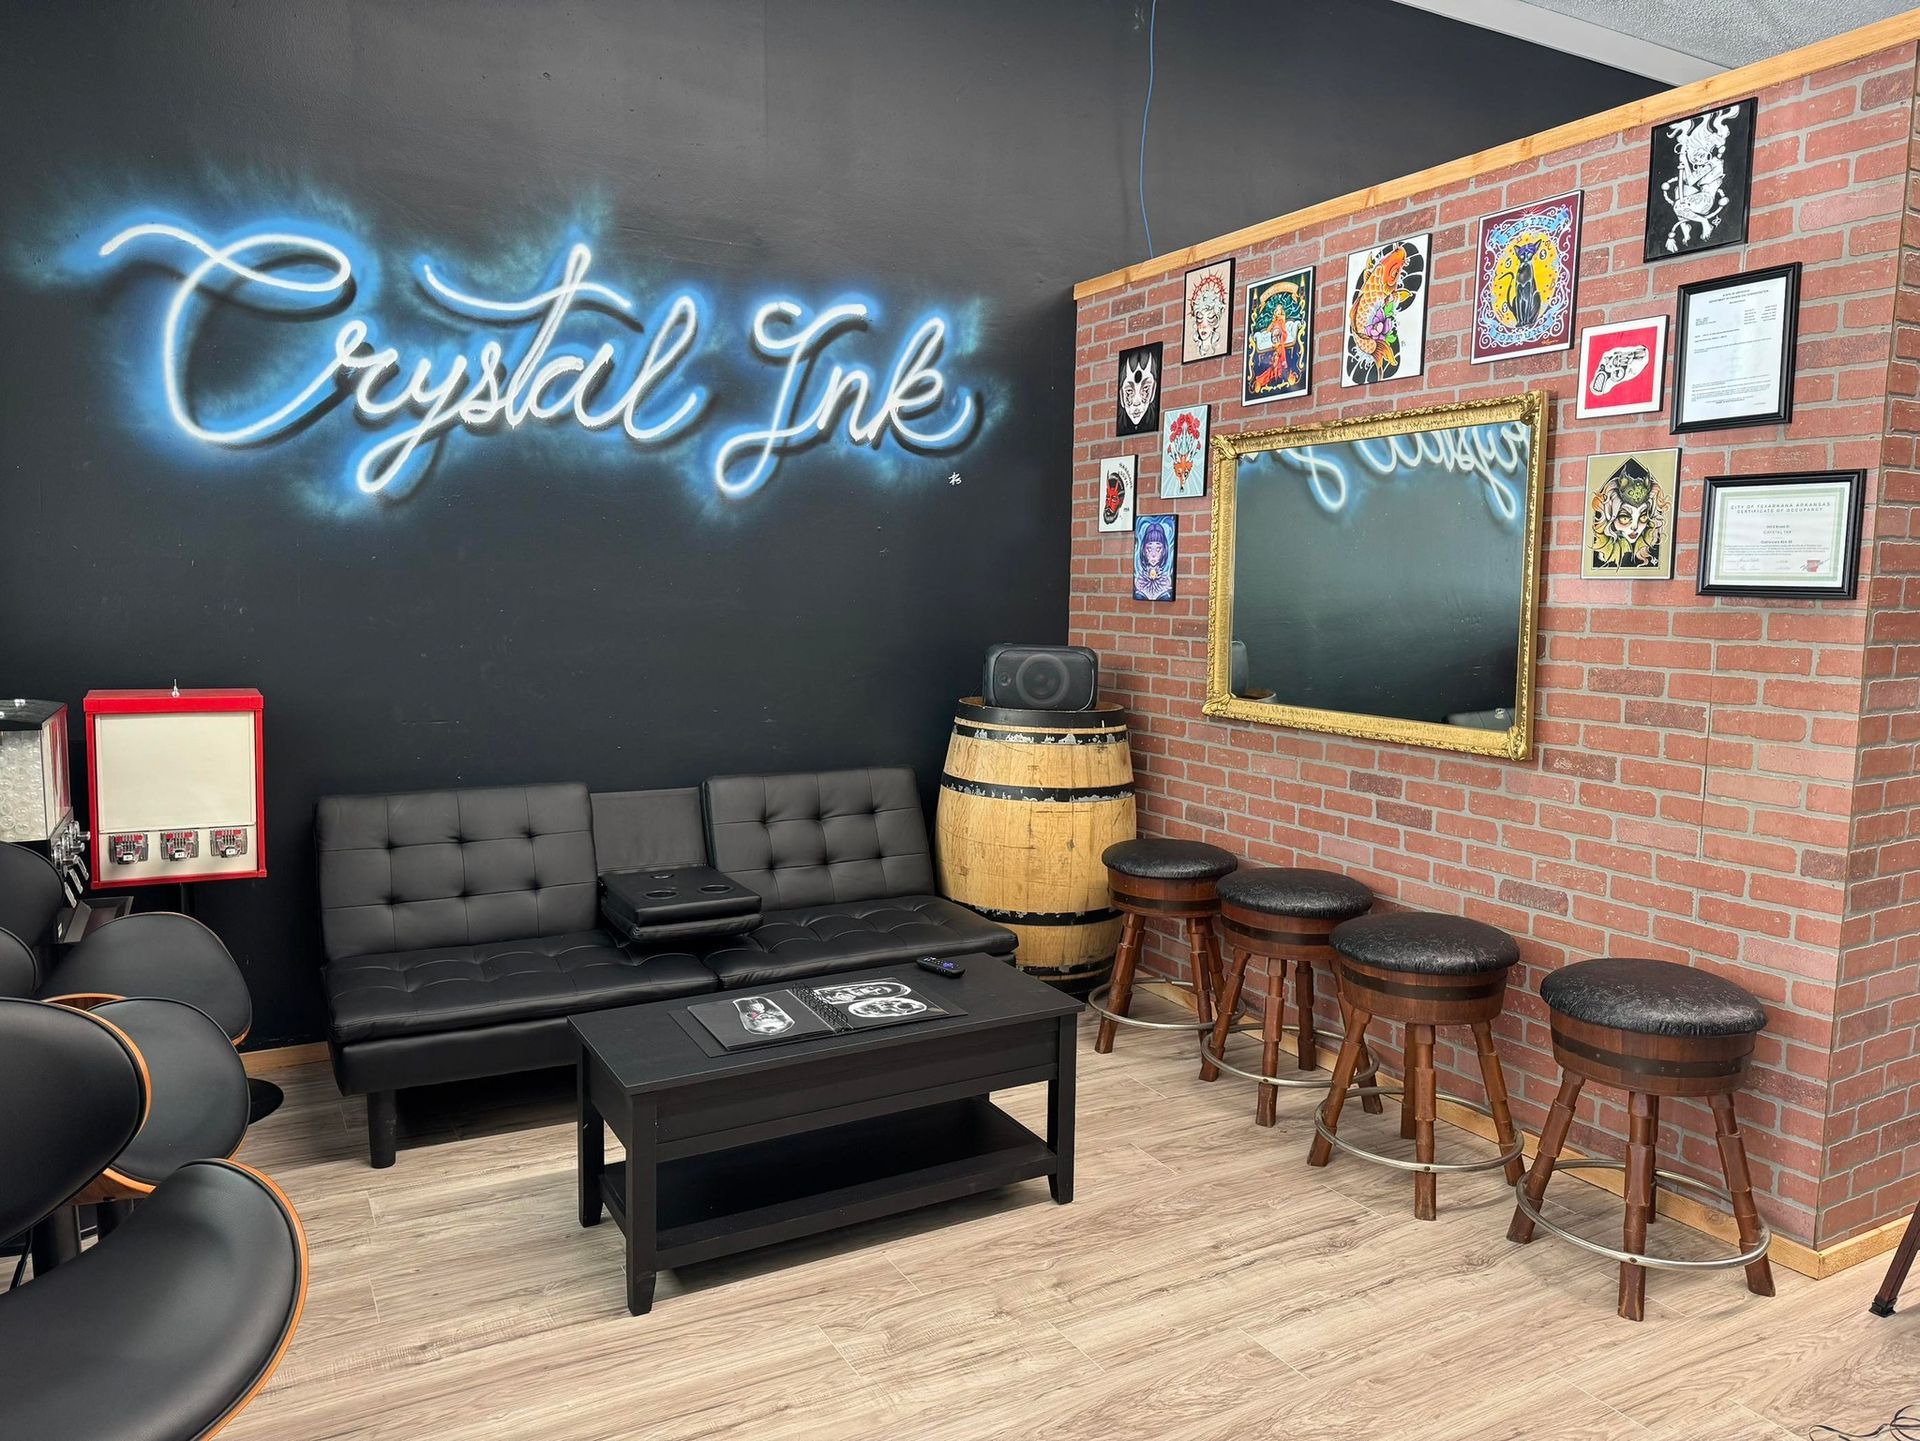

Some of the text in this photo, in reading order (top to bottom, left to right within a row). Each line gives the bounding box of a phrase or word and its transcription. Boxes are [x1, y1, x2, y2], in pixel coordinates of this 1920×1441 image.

[1506, 217, 1555, 238] FELINE
[99, 225, 973, 494] Crystal Ink
